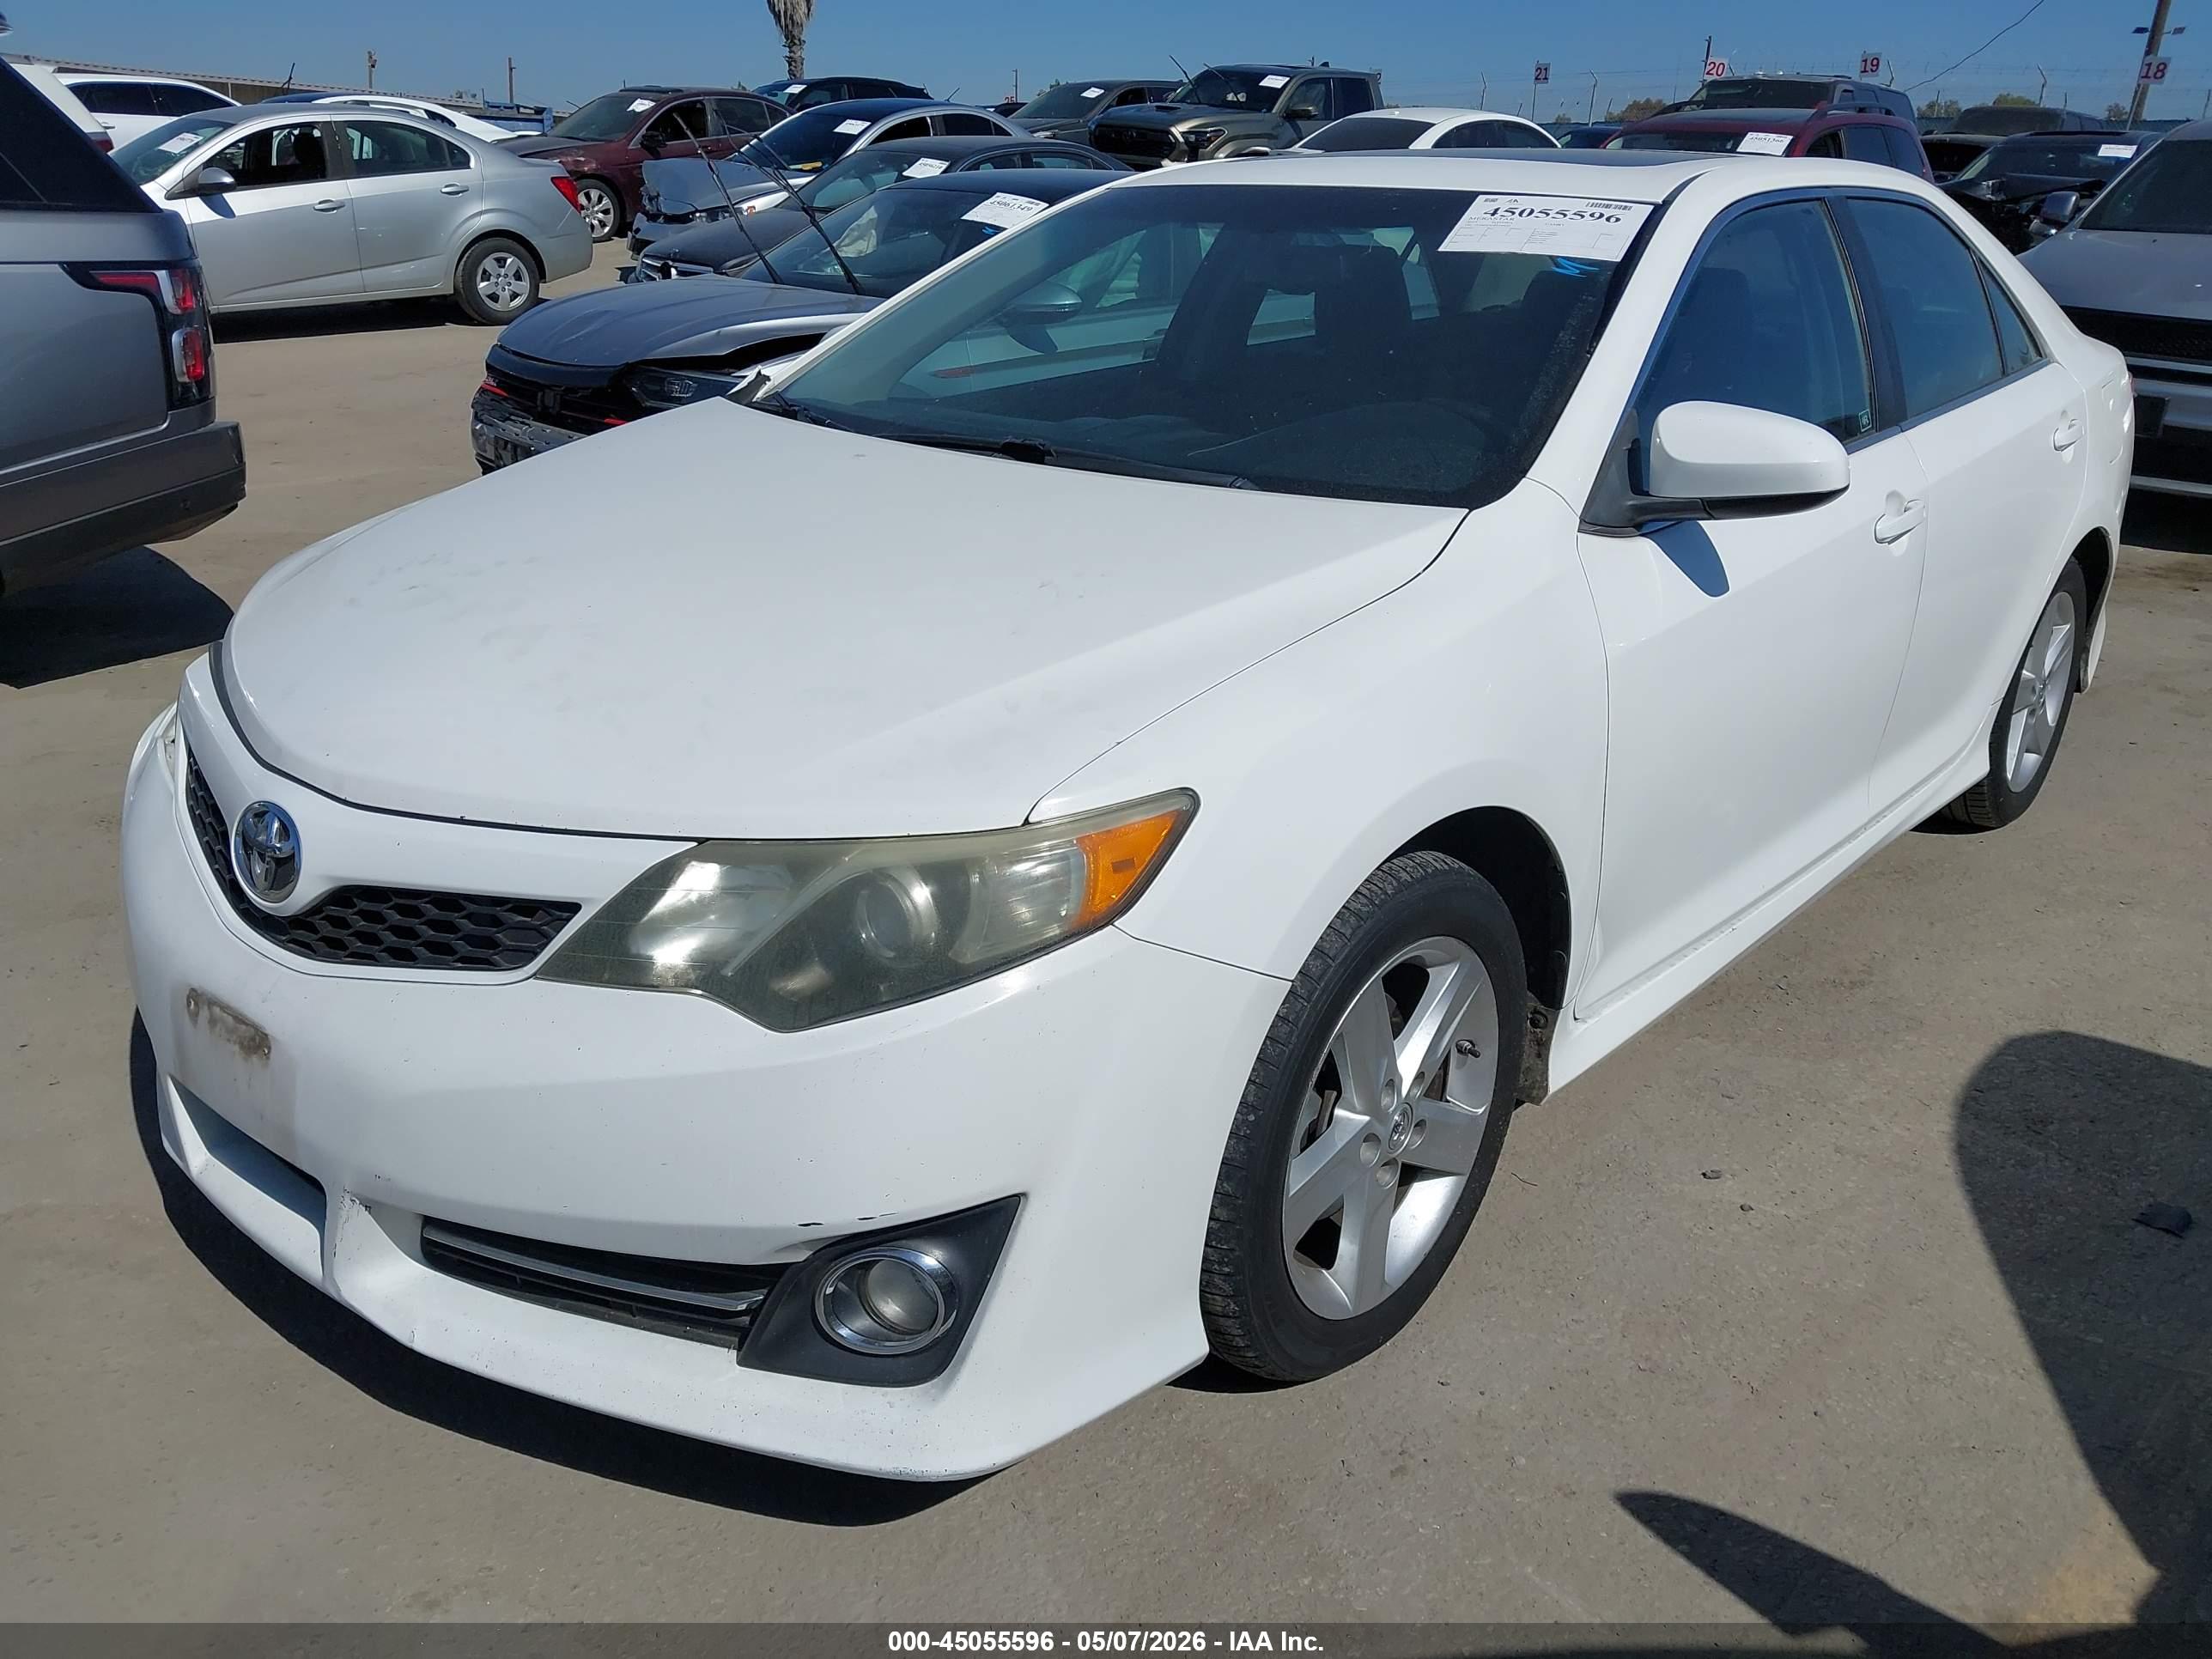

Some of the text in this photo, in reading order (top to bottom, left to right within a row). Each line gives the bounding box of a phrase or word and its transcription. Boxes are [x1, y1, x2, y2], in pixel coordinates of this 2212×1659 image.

[1705, 62, 1726, 76] 20
[1860, 57, 1880, 73] 19
[2141, 62, 2167, 79] 18
[1534, 67, 1549, 81] 21
[1483, 206, 1623, 225] 45055596
